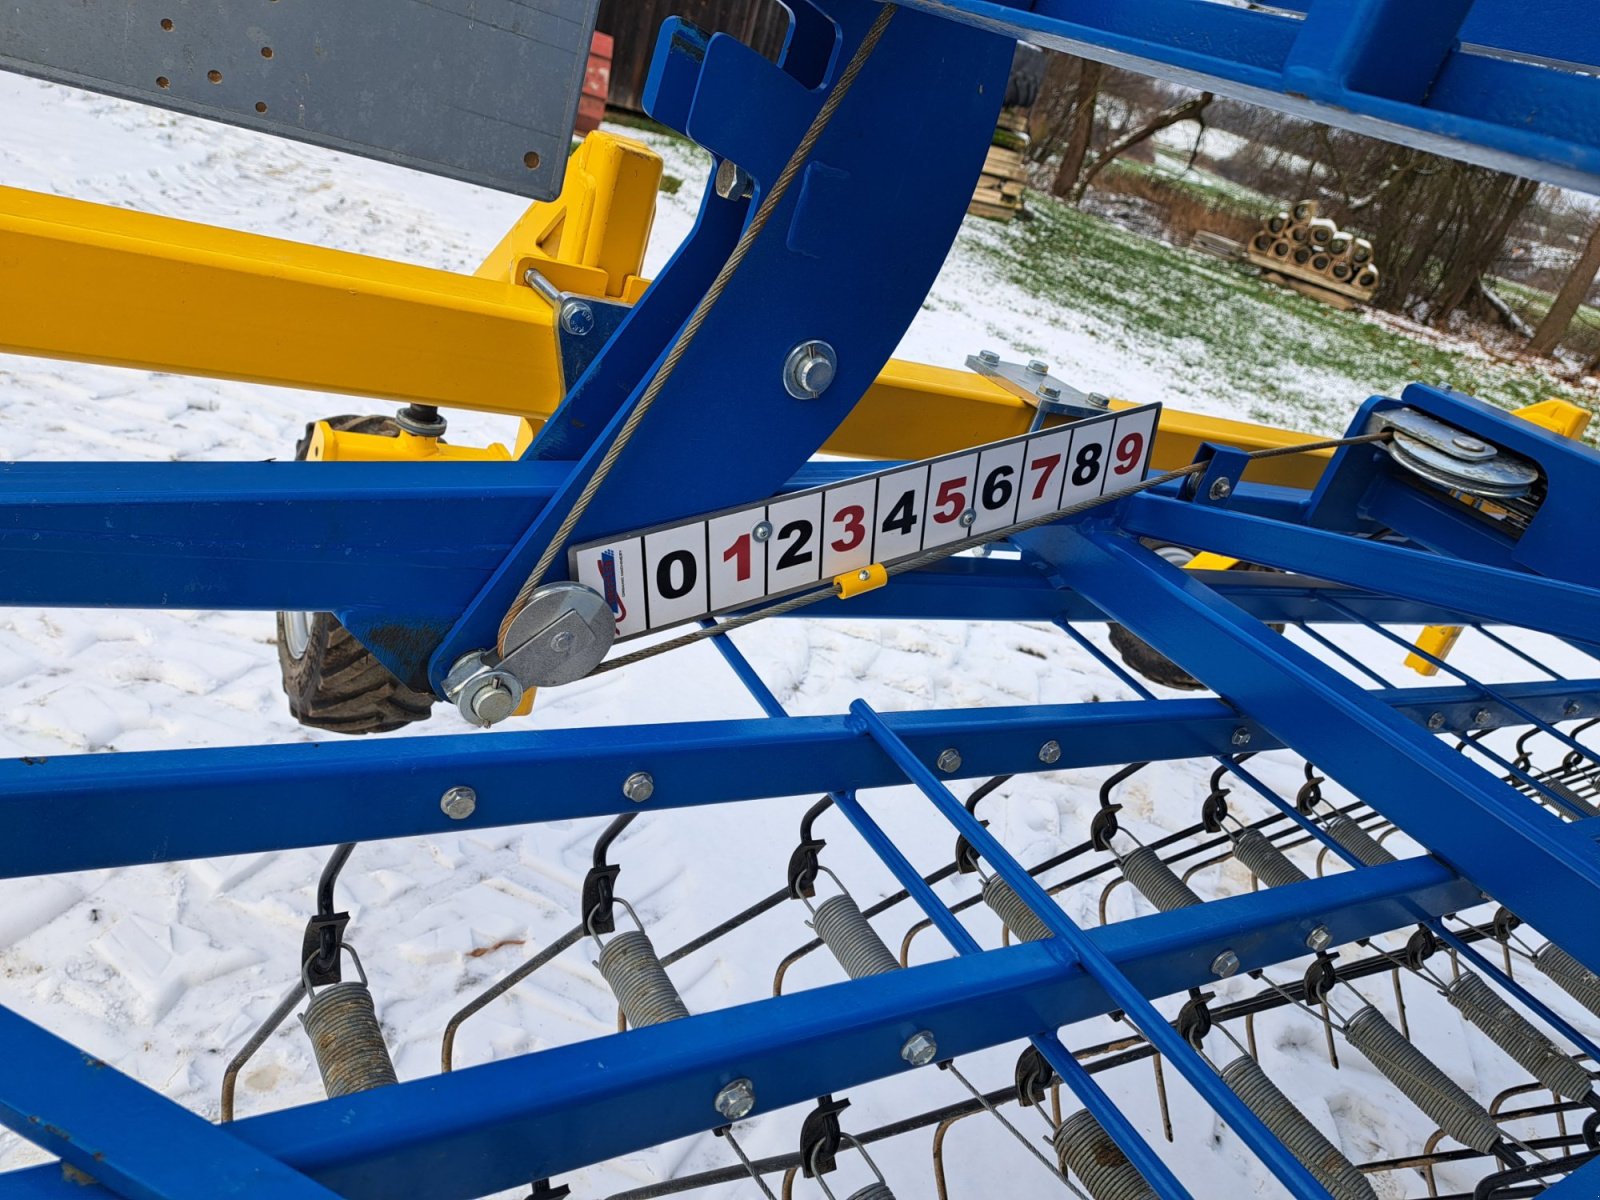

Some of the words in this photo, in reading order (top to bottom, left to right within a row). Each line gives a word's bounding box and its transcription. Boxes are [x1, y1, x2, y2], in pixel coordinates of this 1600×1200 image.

[656, 549, 697, 600] 0
[723, 533, 751, 581] 1
[775, 519, 813, 571] 2
[831, 505, 865, 553] 3
[881, 489, 918, 536] 4
[932, 477, 967, 524] 5
[981, 465, 1015, 511] 6
[1031, 454, 1061, 500] 7
[1071, 442, 1103, 487] 8
[1113, 432, 1143, 475] 9
